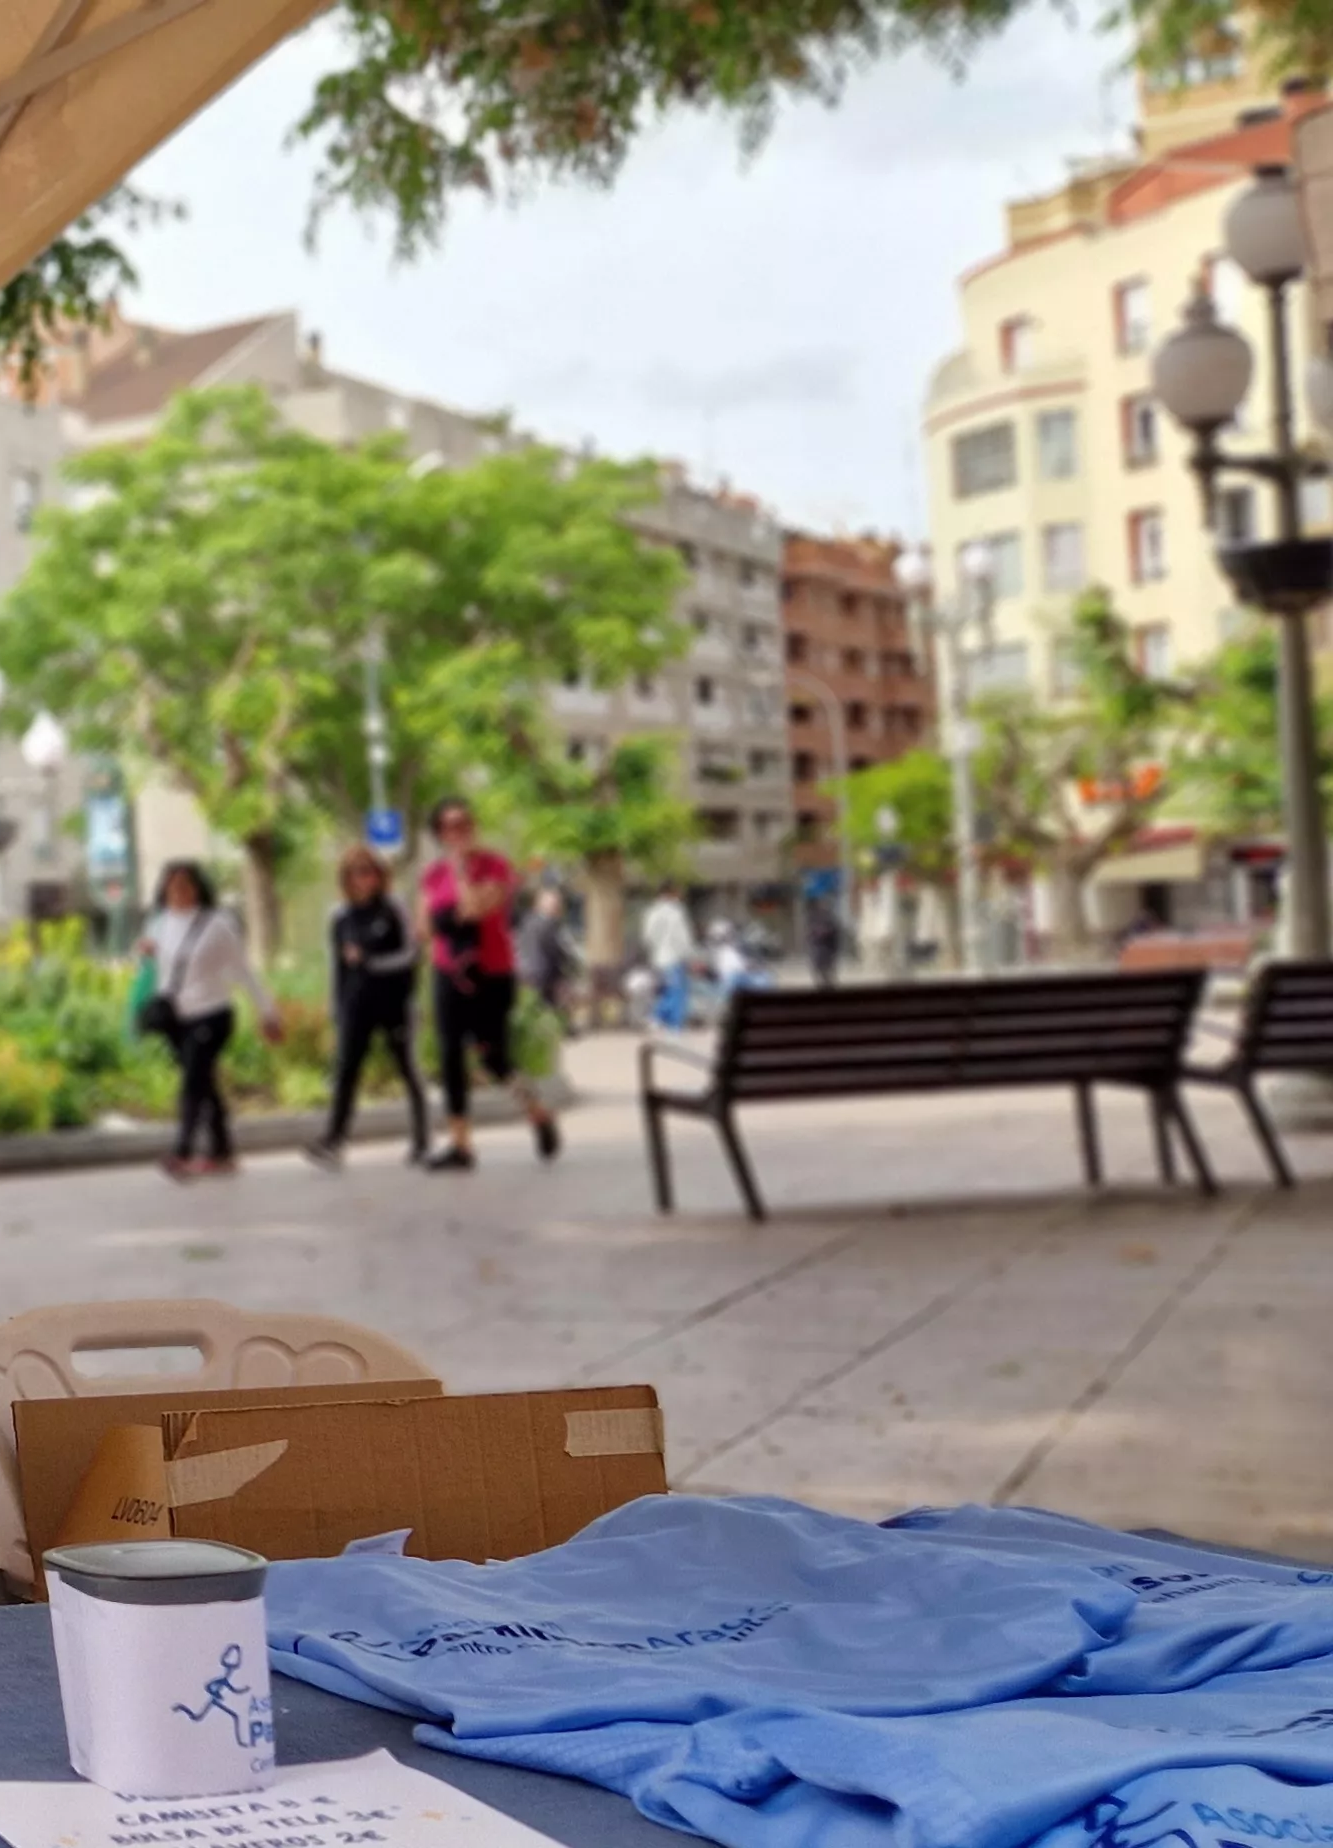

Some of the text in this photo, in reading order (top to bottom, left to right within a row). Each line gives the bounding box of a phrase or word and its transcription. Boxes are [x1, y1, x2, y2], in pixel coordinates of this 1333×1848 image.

[116, 1803, 272, 1826] CAMISETA
[108, 1827, 208, 1846] BOLSA
[212, 1823, 251, 1837] DE
[259, 1813, 339, 1829] TELA
